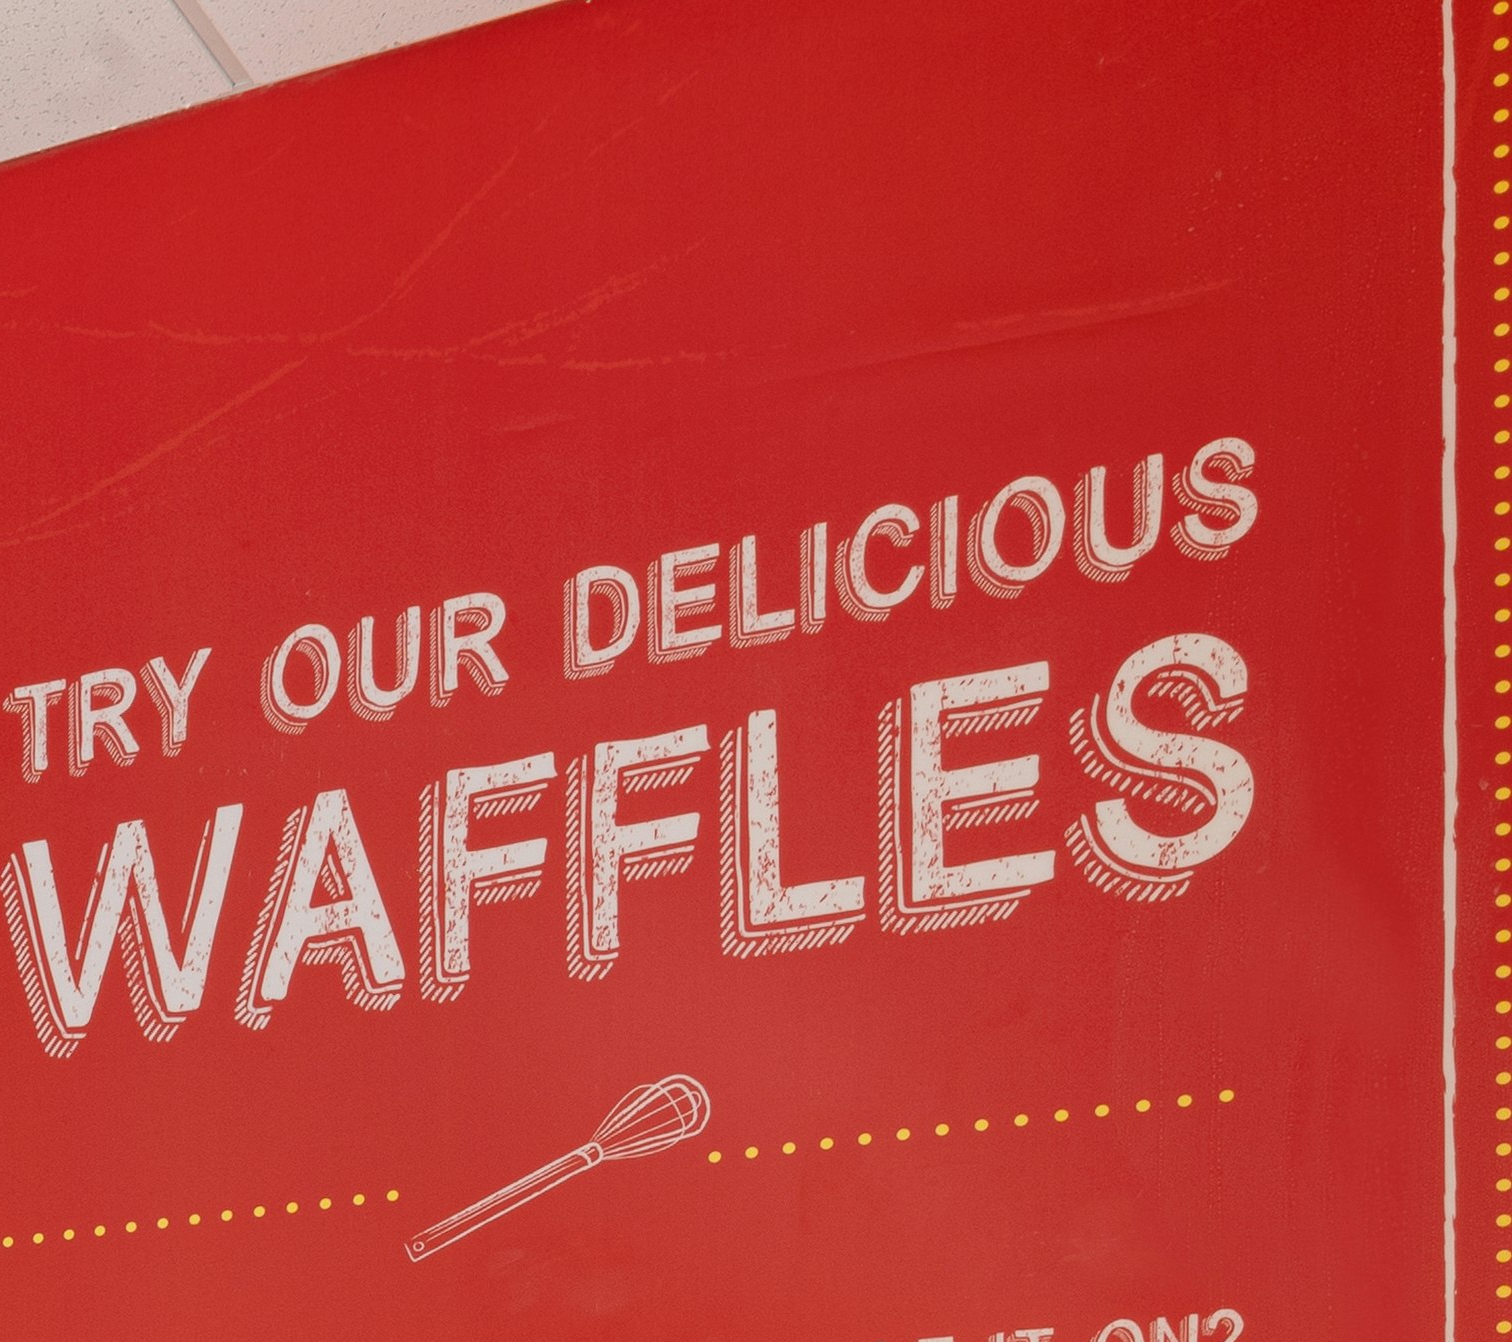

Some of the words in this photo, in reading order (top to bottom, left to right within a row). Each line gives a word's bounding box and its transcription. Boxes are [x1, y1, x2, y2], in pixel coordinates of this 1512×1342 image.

[2, 648, 212, 782] TRY
[260, 591, 509, 733] OUR
[563, 436, 1259, 679] DELICIOUS
[0, 632, 1256, 1059] WAFFLES
